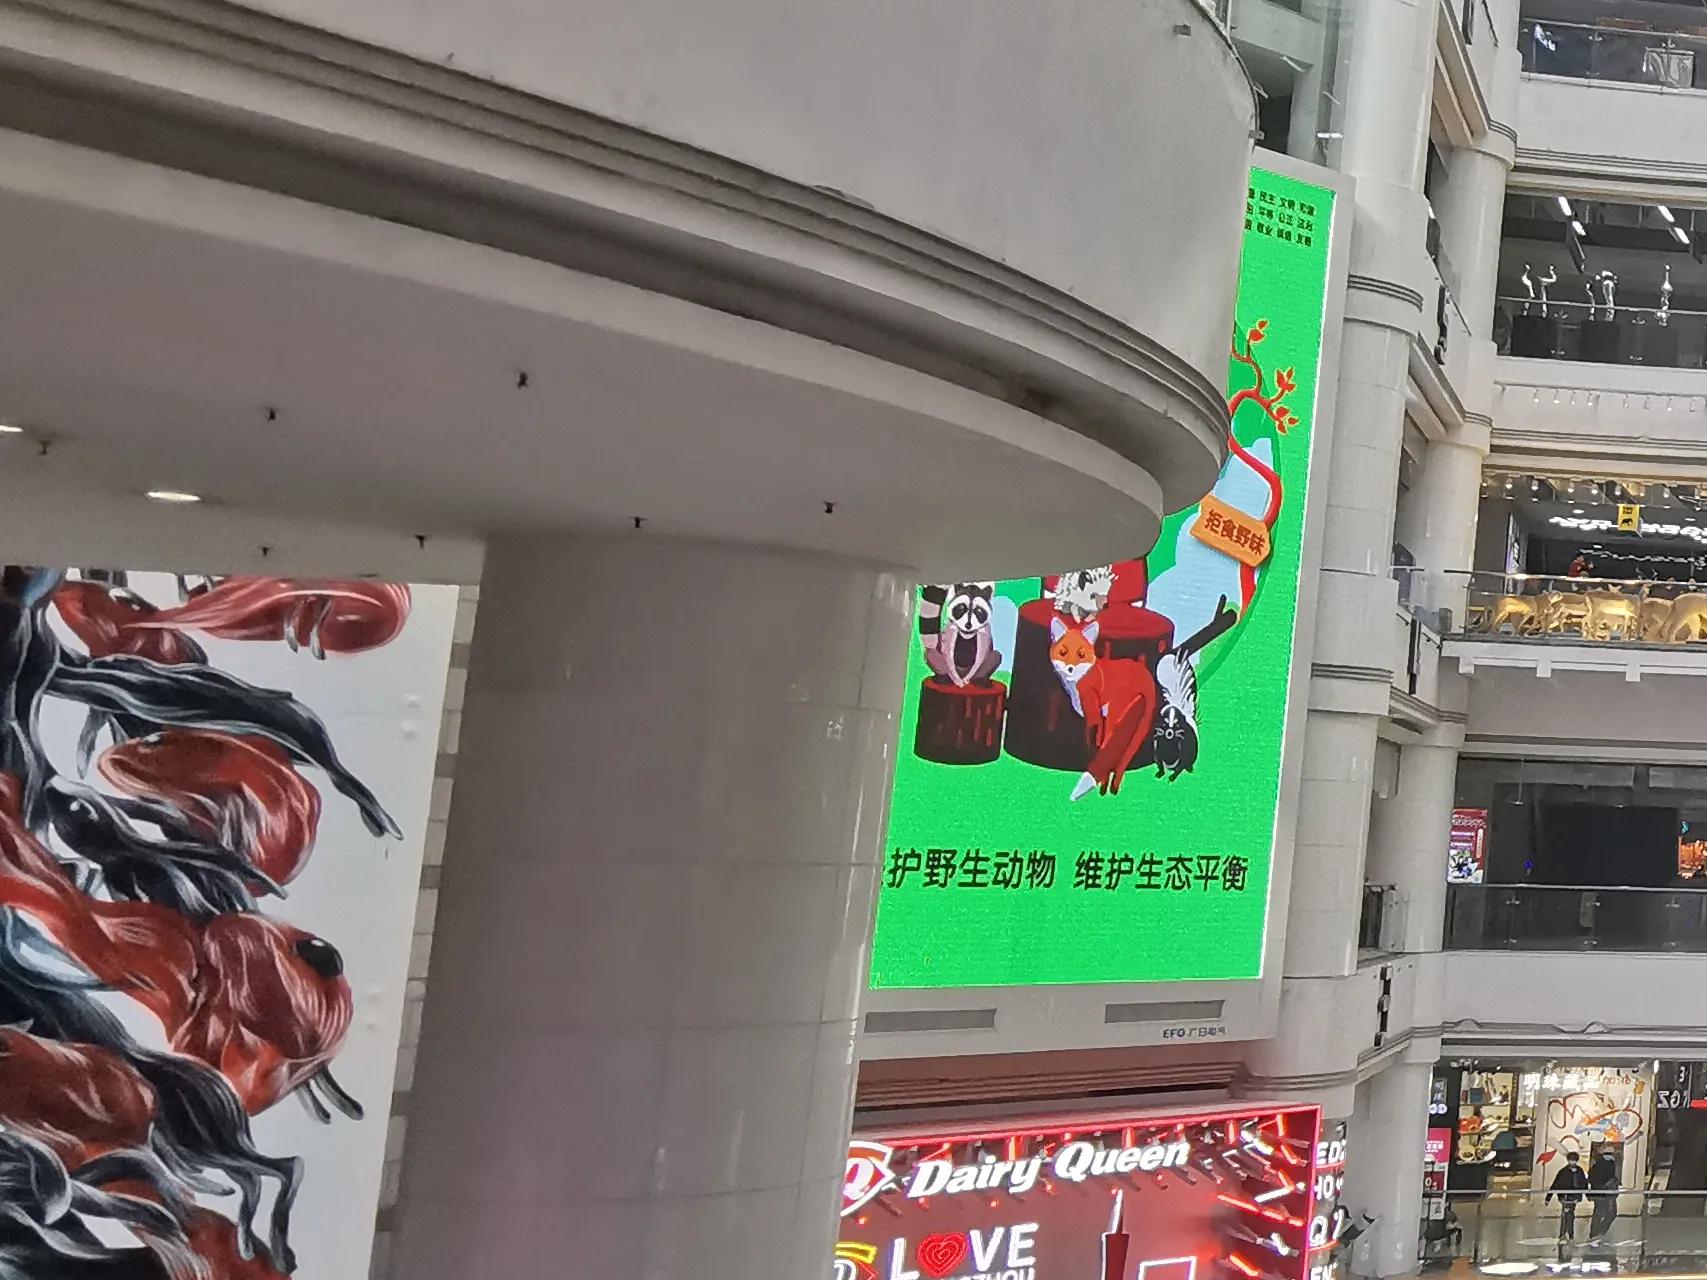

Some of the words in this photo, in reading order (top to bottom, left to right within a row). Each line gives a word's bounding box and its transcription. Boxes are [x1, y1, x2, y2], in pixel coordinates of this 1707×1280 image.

[1072, 850, 1249, 892] 维护生态平衡
[1163, 1028, 1187, 1040] EFO
[907, 1154, 1041, 1200] Dairy
[1054, 1138, 1191, 1185] Queen
